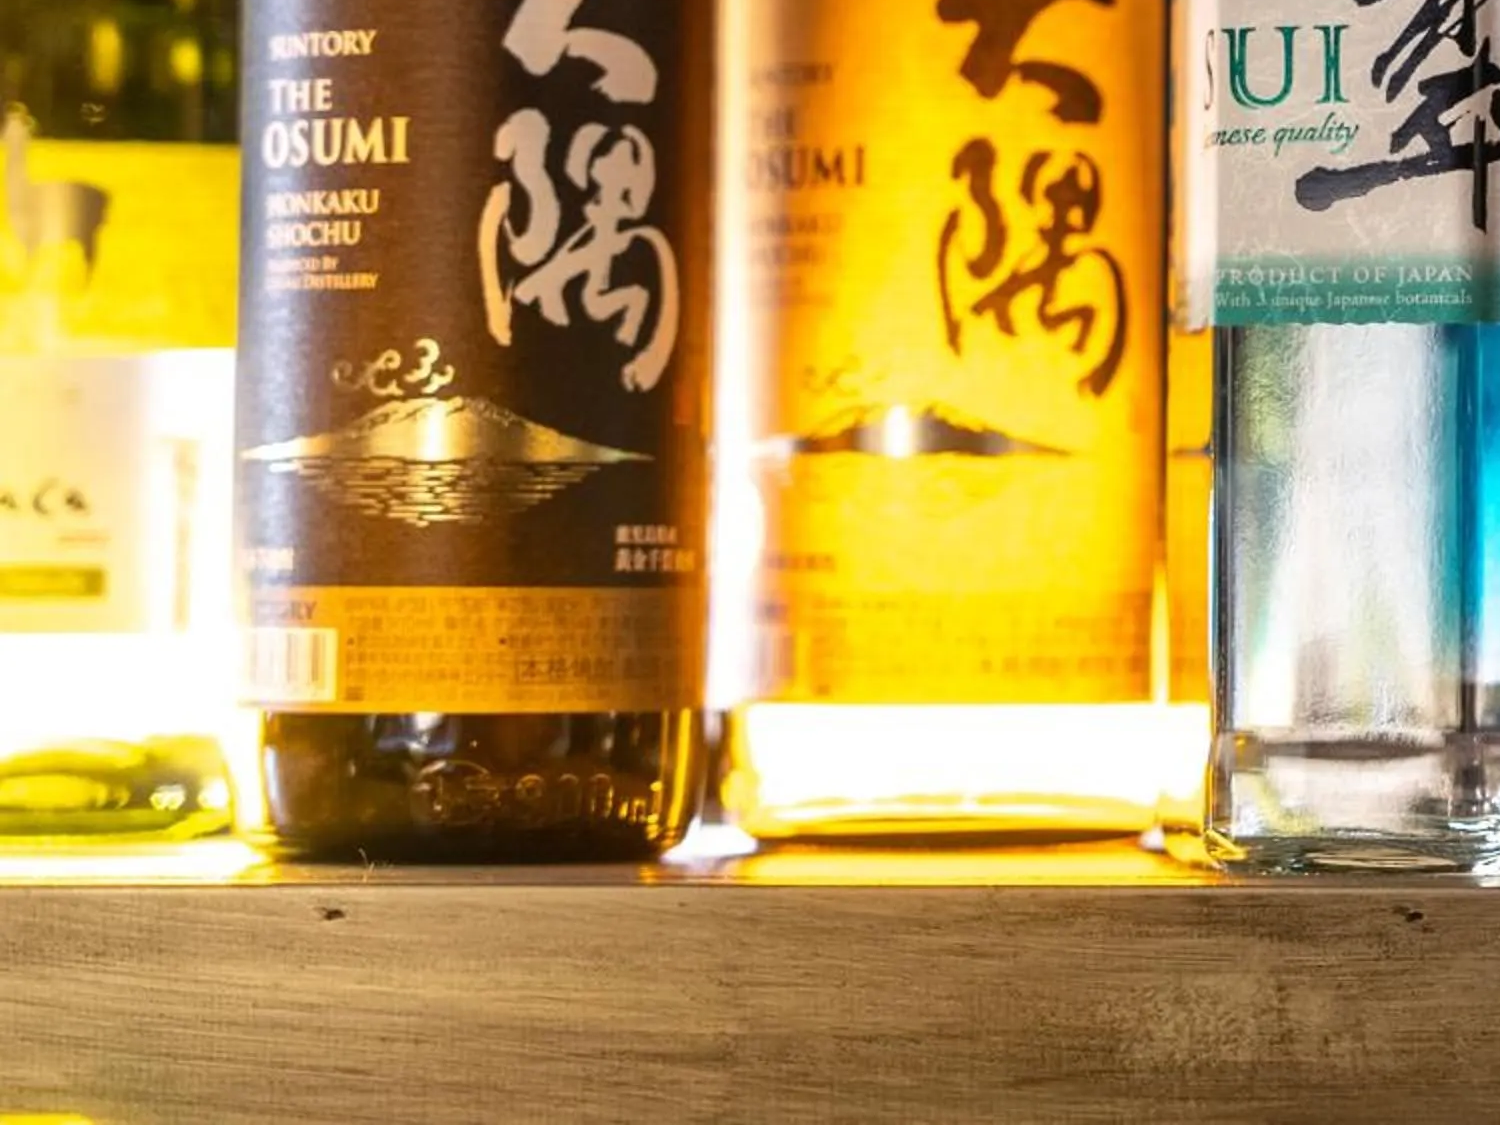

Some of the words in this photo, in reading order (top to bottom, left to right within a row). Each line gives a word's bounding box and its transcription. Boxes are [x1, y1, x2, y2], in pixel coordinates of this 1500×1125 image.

[268, 29, 376, 60] SUNTORY
[268, 79, 333, 114] THE
[262, 117, 410, 168] OSUMI
[1274, 112, 1359, 157] quality
[1216, 266, 1342, 286] PRODUCT
[1353, 266, 1387, 285] OF
[1398, 264, 1473, 287] JAPAN
[1395, 288, 1473, 305] botanicals
